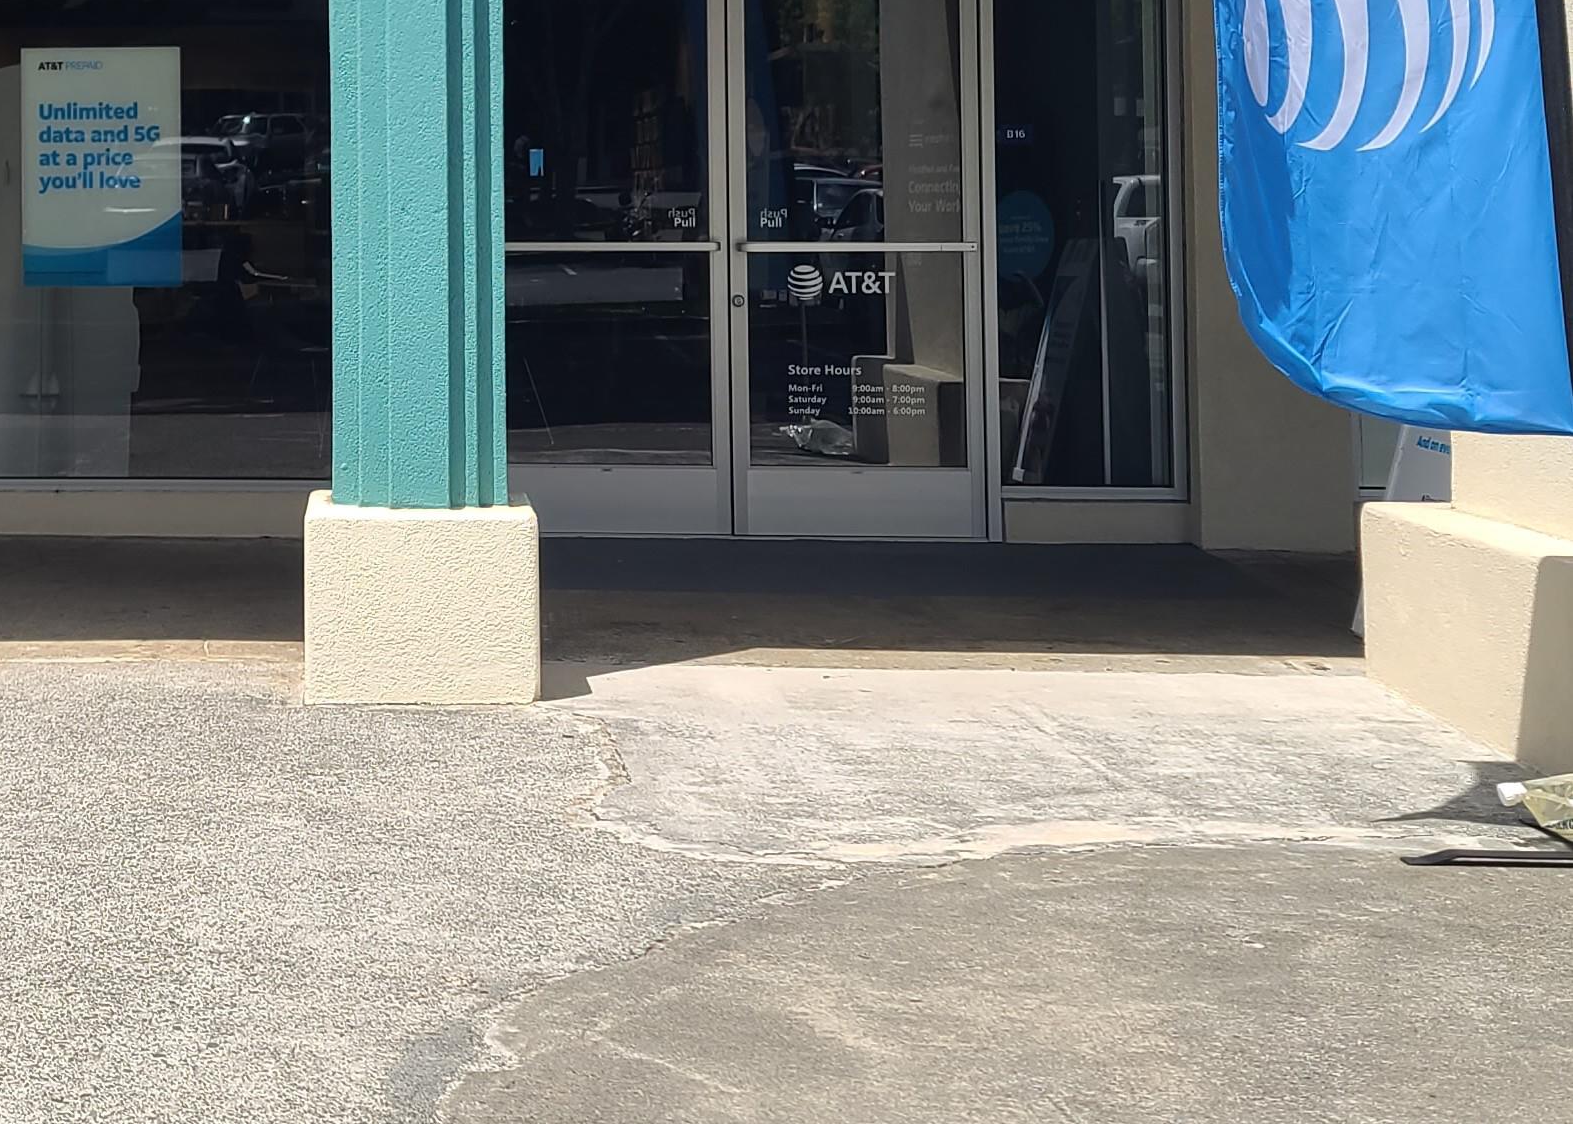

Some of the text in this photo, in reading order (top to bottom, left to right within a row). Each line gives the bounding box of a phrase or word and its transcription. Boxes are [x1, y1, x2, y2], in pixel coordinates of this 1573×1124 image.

[38, 60, 103, 71] AT&T PREPAID
[38, 102, 138, 121] Unlimited
[38, 125, 160, 143] data and 5G
[38, 148, 134, 170] at a price
[38, 171, 142, 194] you'll love
[908, 179, 960, 195] Connectin
[908, 199, 932, 213] Your
[674, 217, 696, 227] Pull
[760, 217, 782, 228] Pull
[828, 272, 896, 294] AT&T
[788, 364, 862, 376] Store Hours
[788, 383, 823, 392] Mon-Fri
[852, 384, 884, 393] 9:00am
[892, 384, 925, 394] 8:00pm
[788, 395, 827, 405] Saturday
[852, 396, 884, 404] 9:00am
[892, 395, 925, 405] 7:00pm
[788, 406, 821, 416] Sunday
[848, 407, 885, 415] 10:00am
[893, 406, 926, 416] 6:00pm
